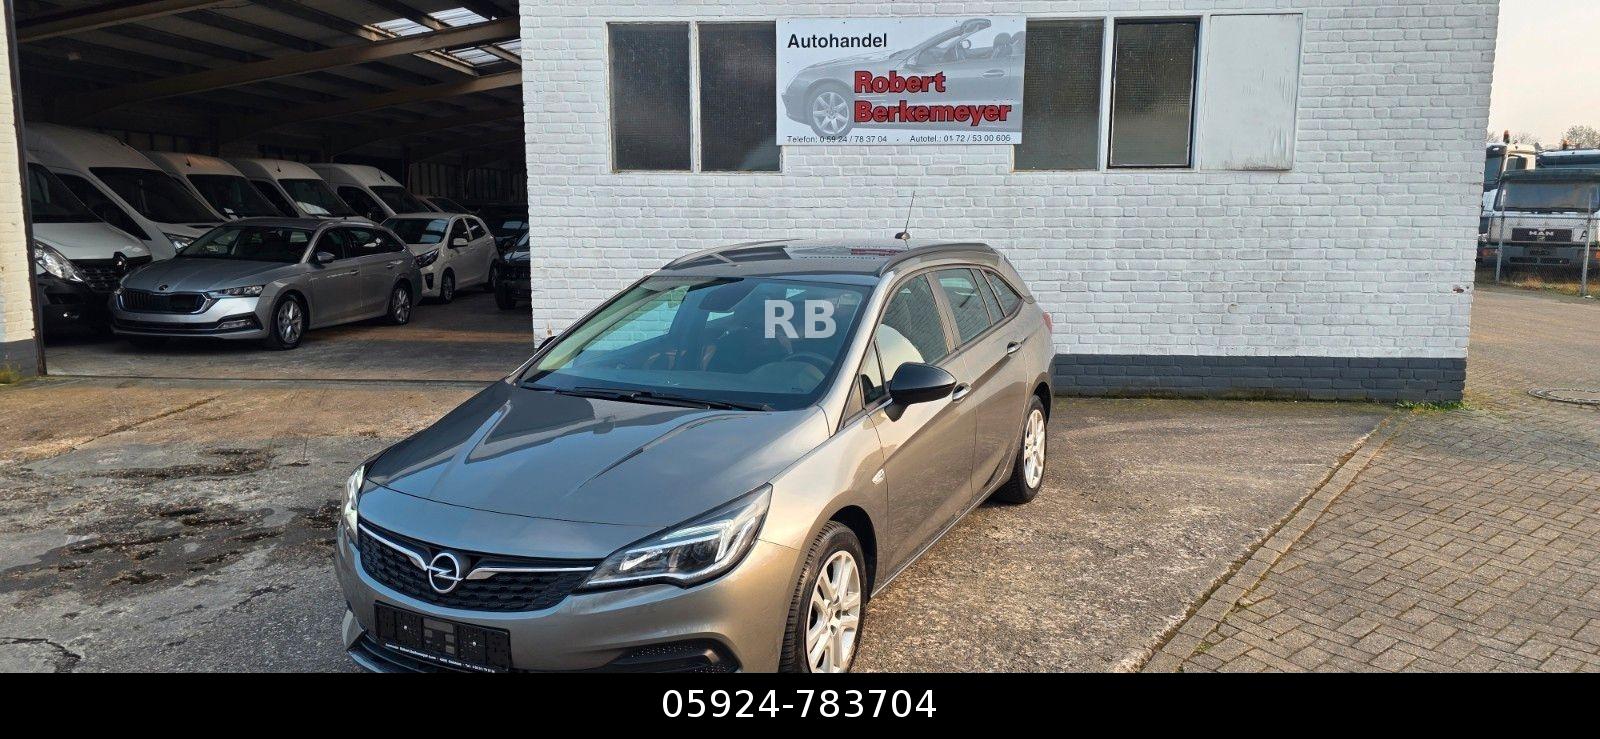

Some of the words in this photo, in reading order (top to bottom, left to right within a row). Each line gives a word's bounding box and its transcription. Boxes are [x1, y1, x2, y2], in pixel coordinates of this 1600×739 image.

[787, 33, 888, 49] Autohandel
[854, 70, 946, 94] Robert
[854, 99, 1012, 126] Berkemeyer
[787, 135, 818, 143] Telefon:
[838, 135, 847, 143] 24
[855, 135, 864, 143] 78
[865, 135, 875, 143] 37
[877, 135, 887, 143] 04
[910, 135, 941, 143] Autotel.:
[984, 134, 994, 142] 00
[996, 134, 1011, 142] 606
